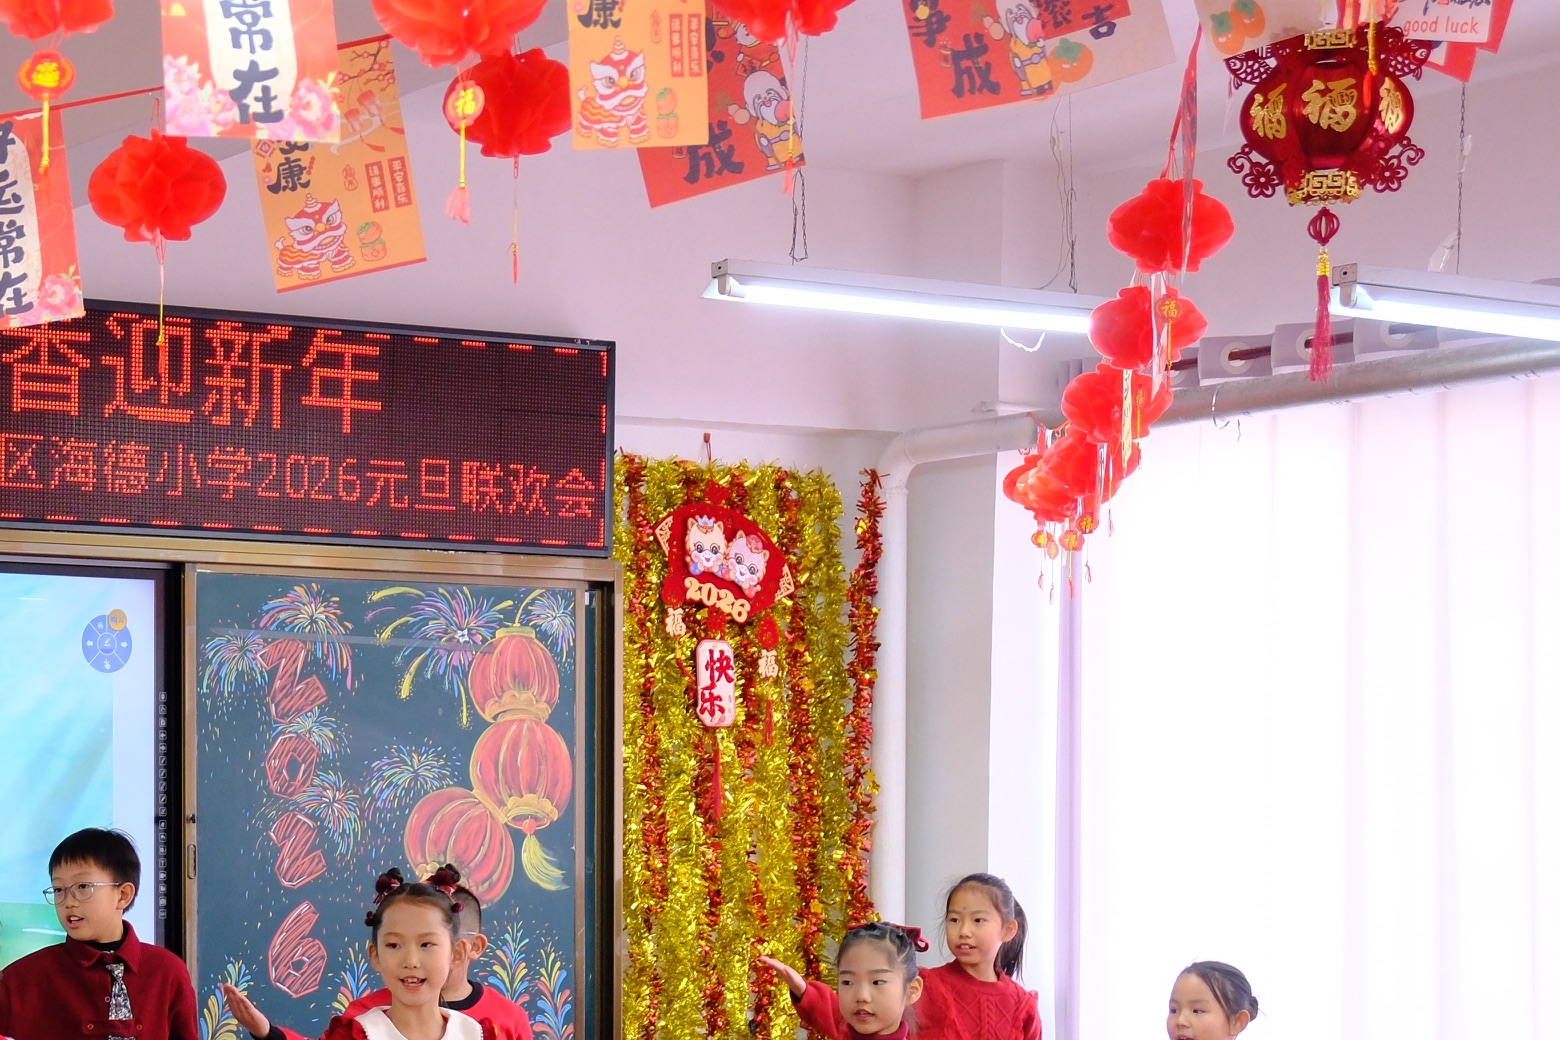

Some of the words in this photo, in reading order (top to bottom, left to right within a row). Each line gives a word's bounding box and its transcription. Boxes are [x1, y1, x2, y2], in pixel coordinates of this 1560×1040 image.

[1403, 16, 1439, 37] good
[1445, 16, 1479, 34] luck
[455, 87, 476, 117] 福
[1251, 83, 1288, 139] 福
[1302, 77, 1358, 132] 福
[1161, 300, 1178, 319] 福
[684, 577, 751, 624] 2026
[665, 607, 687, 638] 福
[758, 649, 779, 679] 福
[699, 649, 736, 723] 快乐
[255, 638, 328, 998] 2026
